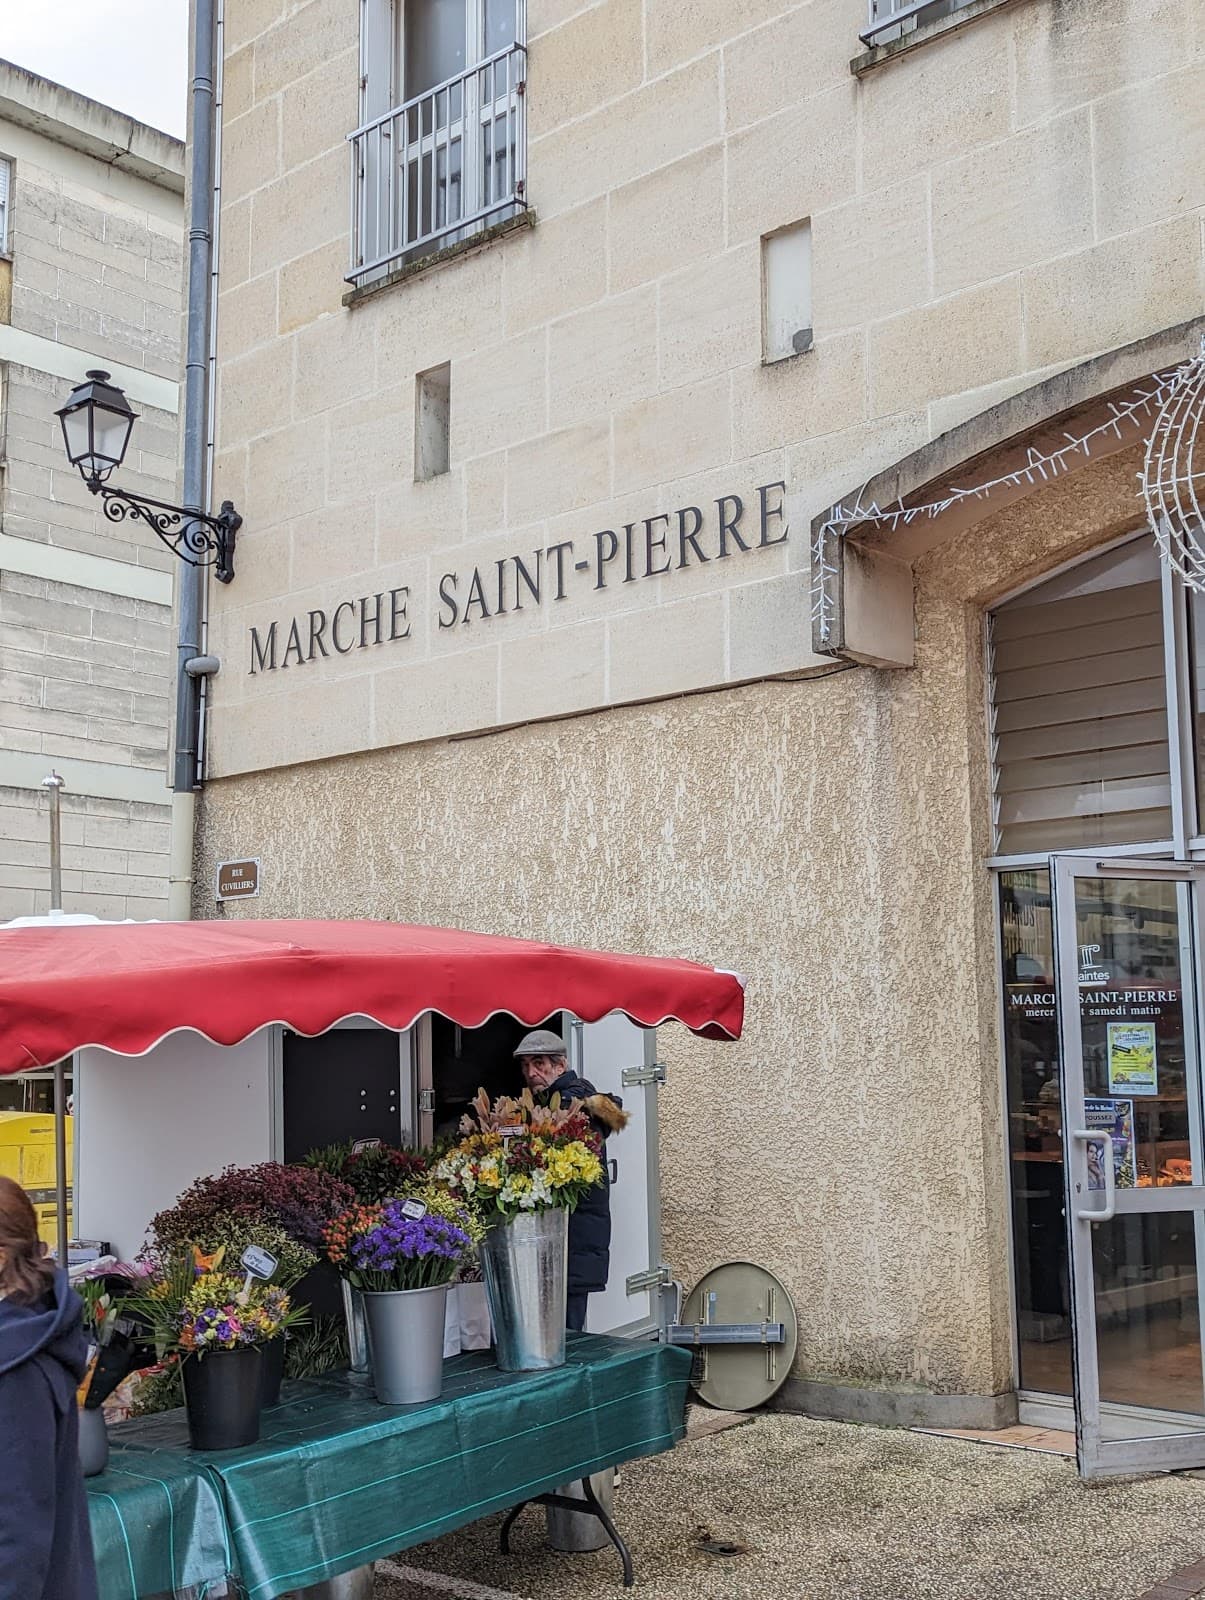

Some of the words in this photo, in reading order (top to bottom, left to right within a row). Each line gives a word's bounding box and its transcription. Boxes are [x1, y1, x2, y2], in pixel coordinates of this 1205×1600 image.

[247, 586, 411, 675] MARCHE
[438, 480, 790, 629] SAINT-PIERRE
[231, 869, 244, 877] RUE
[1078, 971, 1110, 982] aintes
[1011, 993, 1056, 1006] MARC
[1078, 990, 1177, 1003] SAINT-PIERRE
[1025, 1009, 1054, 1017] mercr
[1089, 1005, 1127, 1016] samedi
[1130, 1004, 1161, 1015] matin
